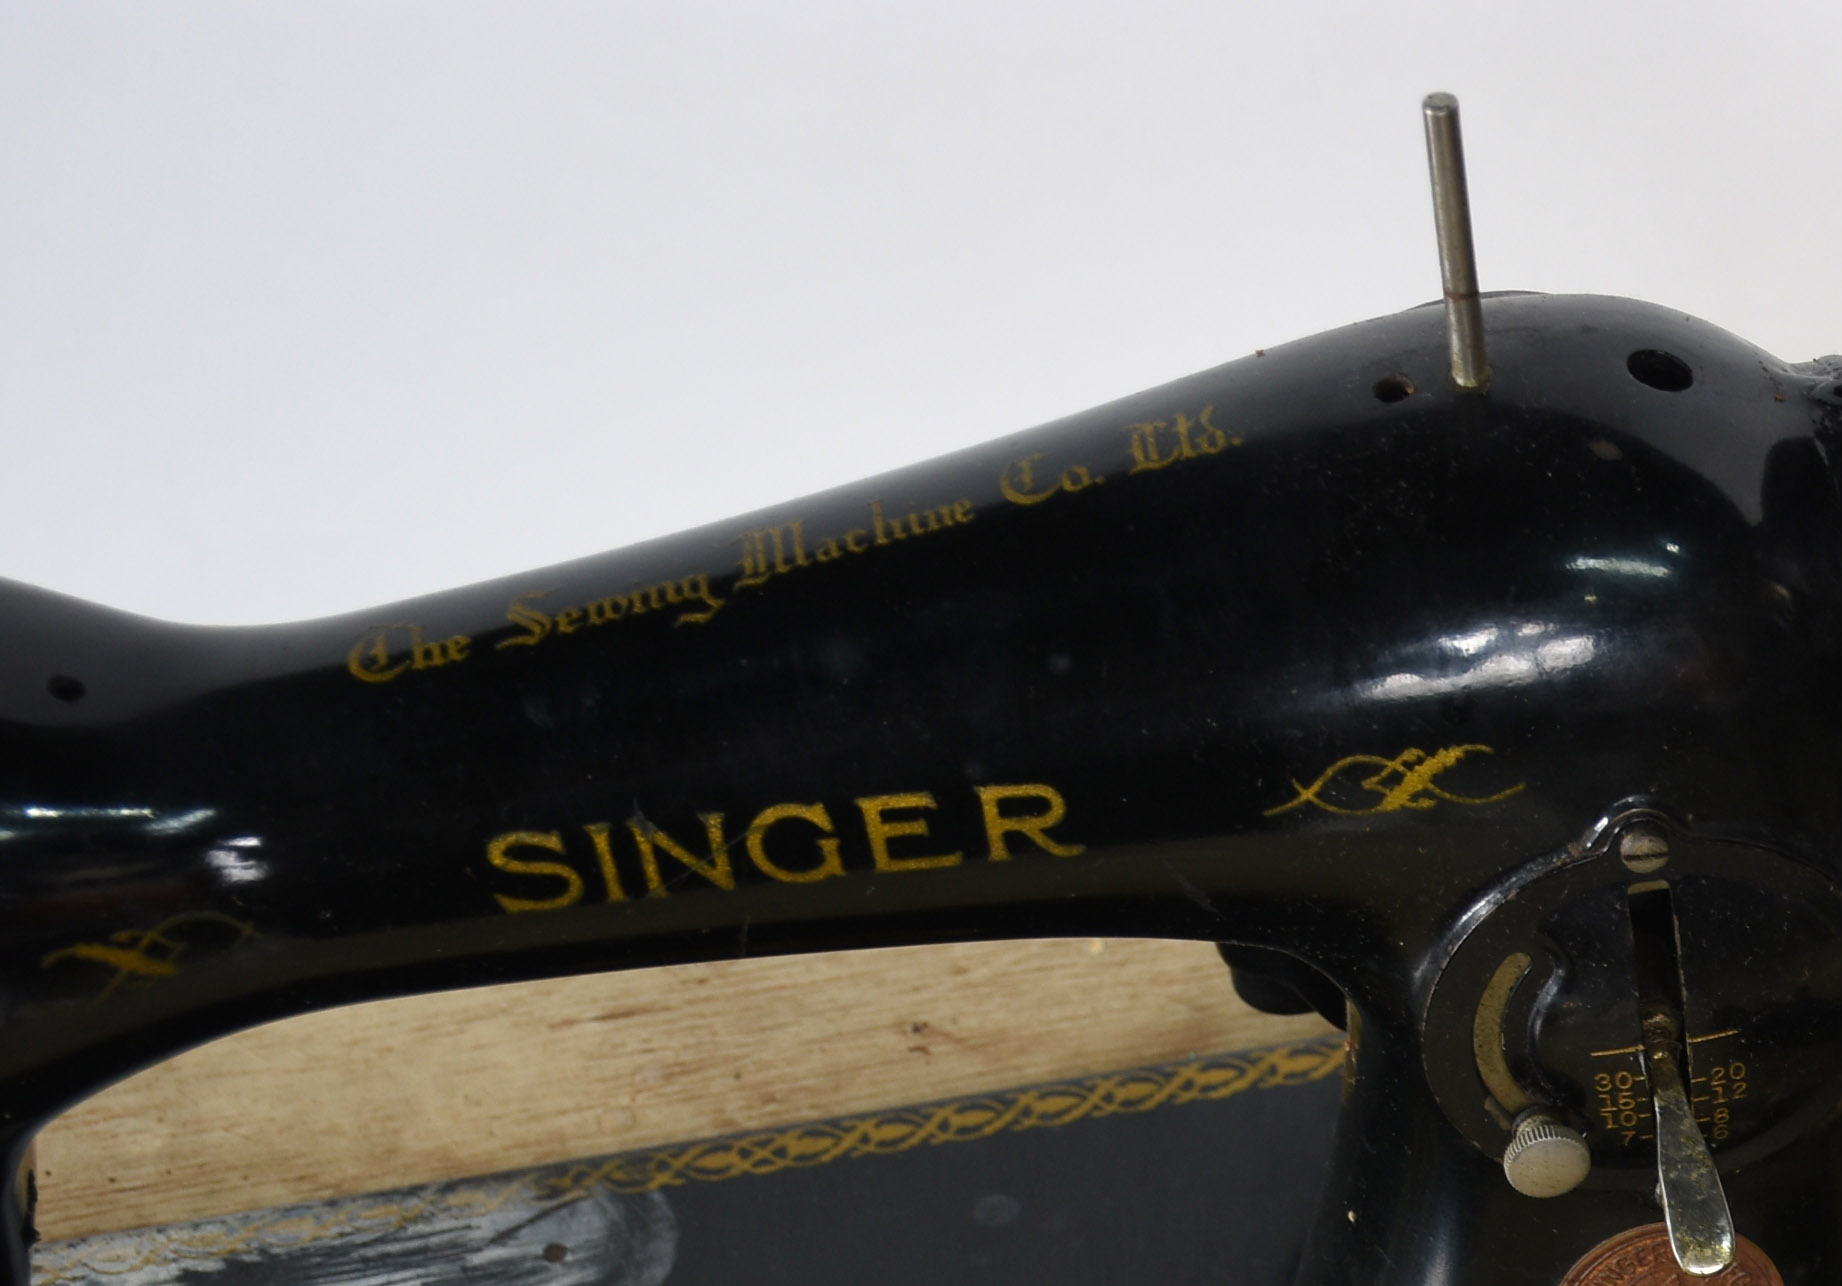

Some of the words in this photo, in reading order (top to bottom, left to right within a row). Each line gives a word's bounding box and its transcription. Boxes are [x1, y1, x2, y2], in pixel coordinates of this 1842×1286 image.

[346, 622, 472, 684] The
[494, 571, 727, 650] Sewing
[732, 497, 976, 588] Machine
[999, 452, 1106, 507] Co.
[1126, 404, 1246, 474] Ltd.
[485, 782, 1086, 916] SINGER
[1594, 1070, 1633, 1092] 30
[1710, 1062, 1747, 1085] 20
[1598, 1093, 1636, 1111] 15
[1713, 1082, 1747, 1103] 12
[1600, 1110, 1638, 1129] 10
[1713, 1107, 1730, 1124] 8
[1713, 1126, 1730, 1141] 6
